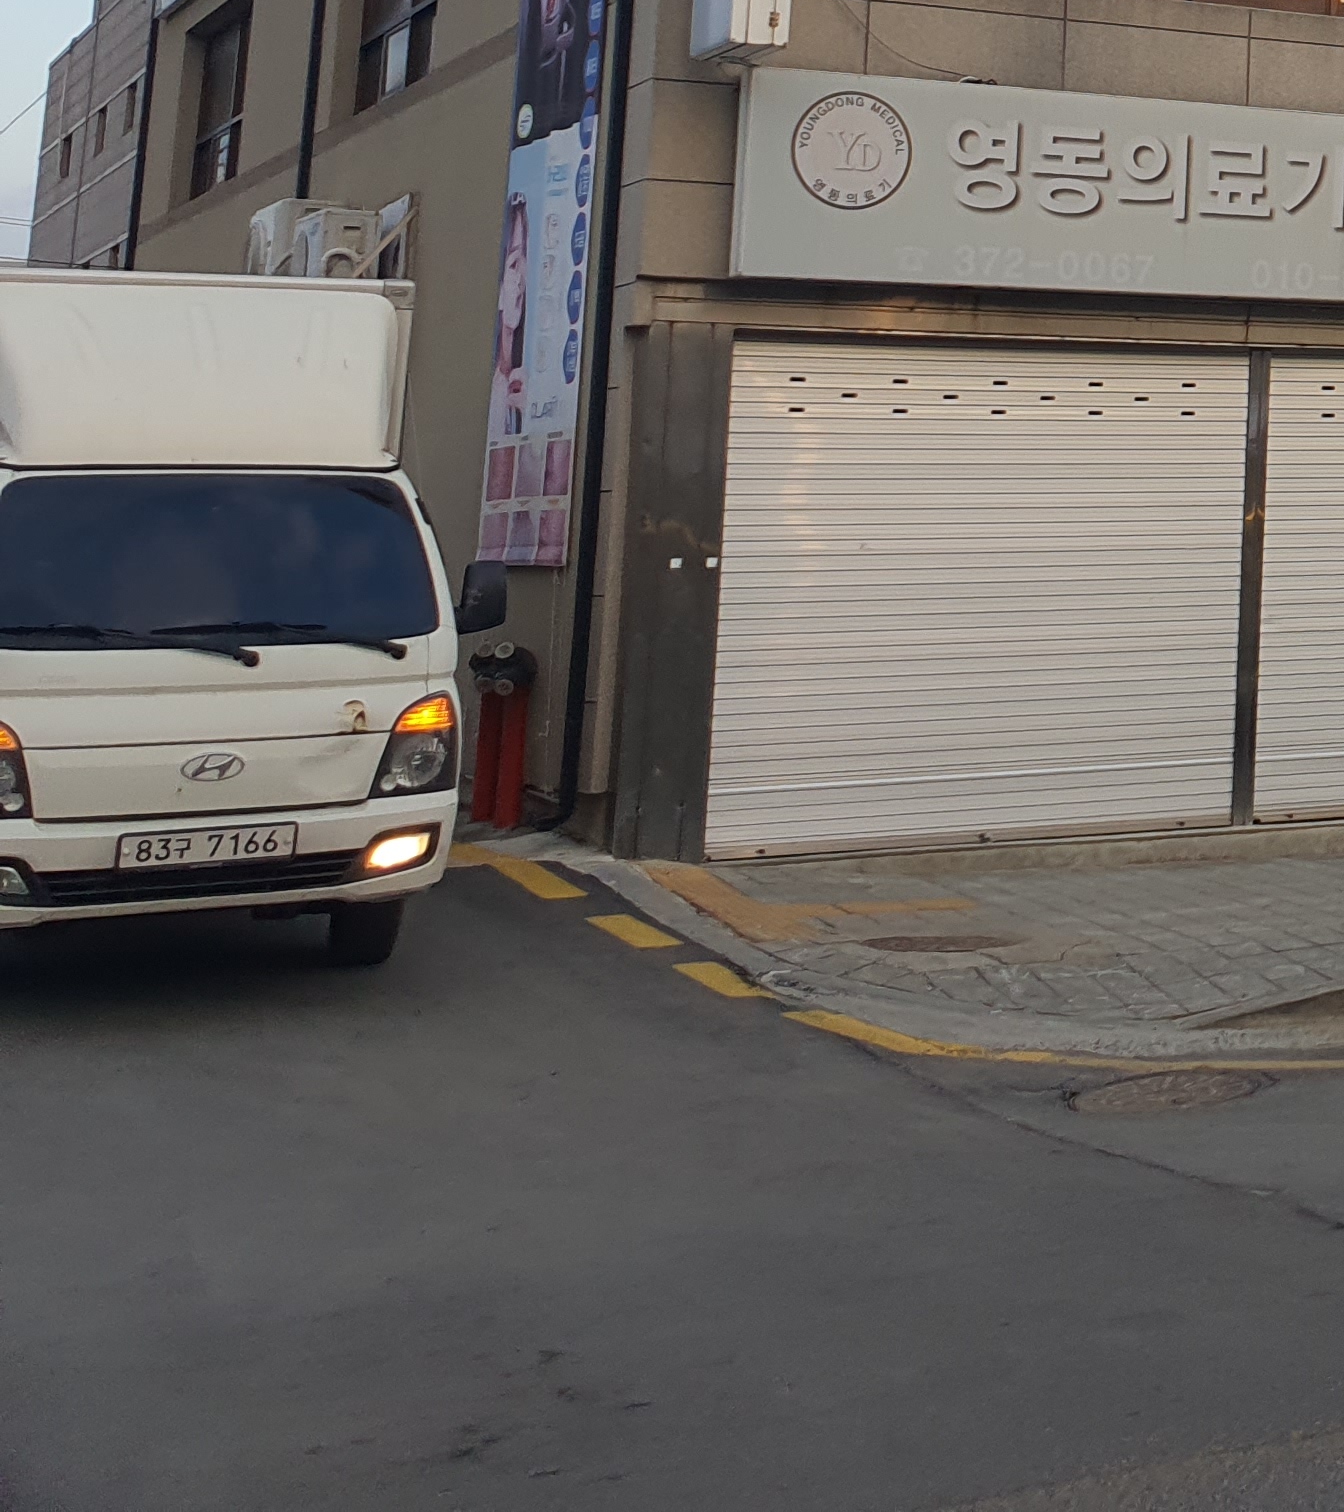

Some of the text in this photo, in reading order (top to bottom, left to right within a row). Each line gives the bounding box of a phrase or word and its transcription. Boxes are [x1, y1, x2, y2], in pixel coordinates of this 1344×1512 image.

[798, 96, 905, 156] YOUNGDONG MEDICAL
[135, 829, 279, 863] 83구 7166
